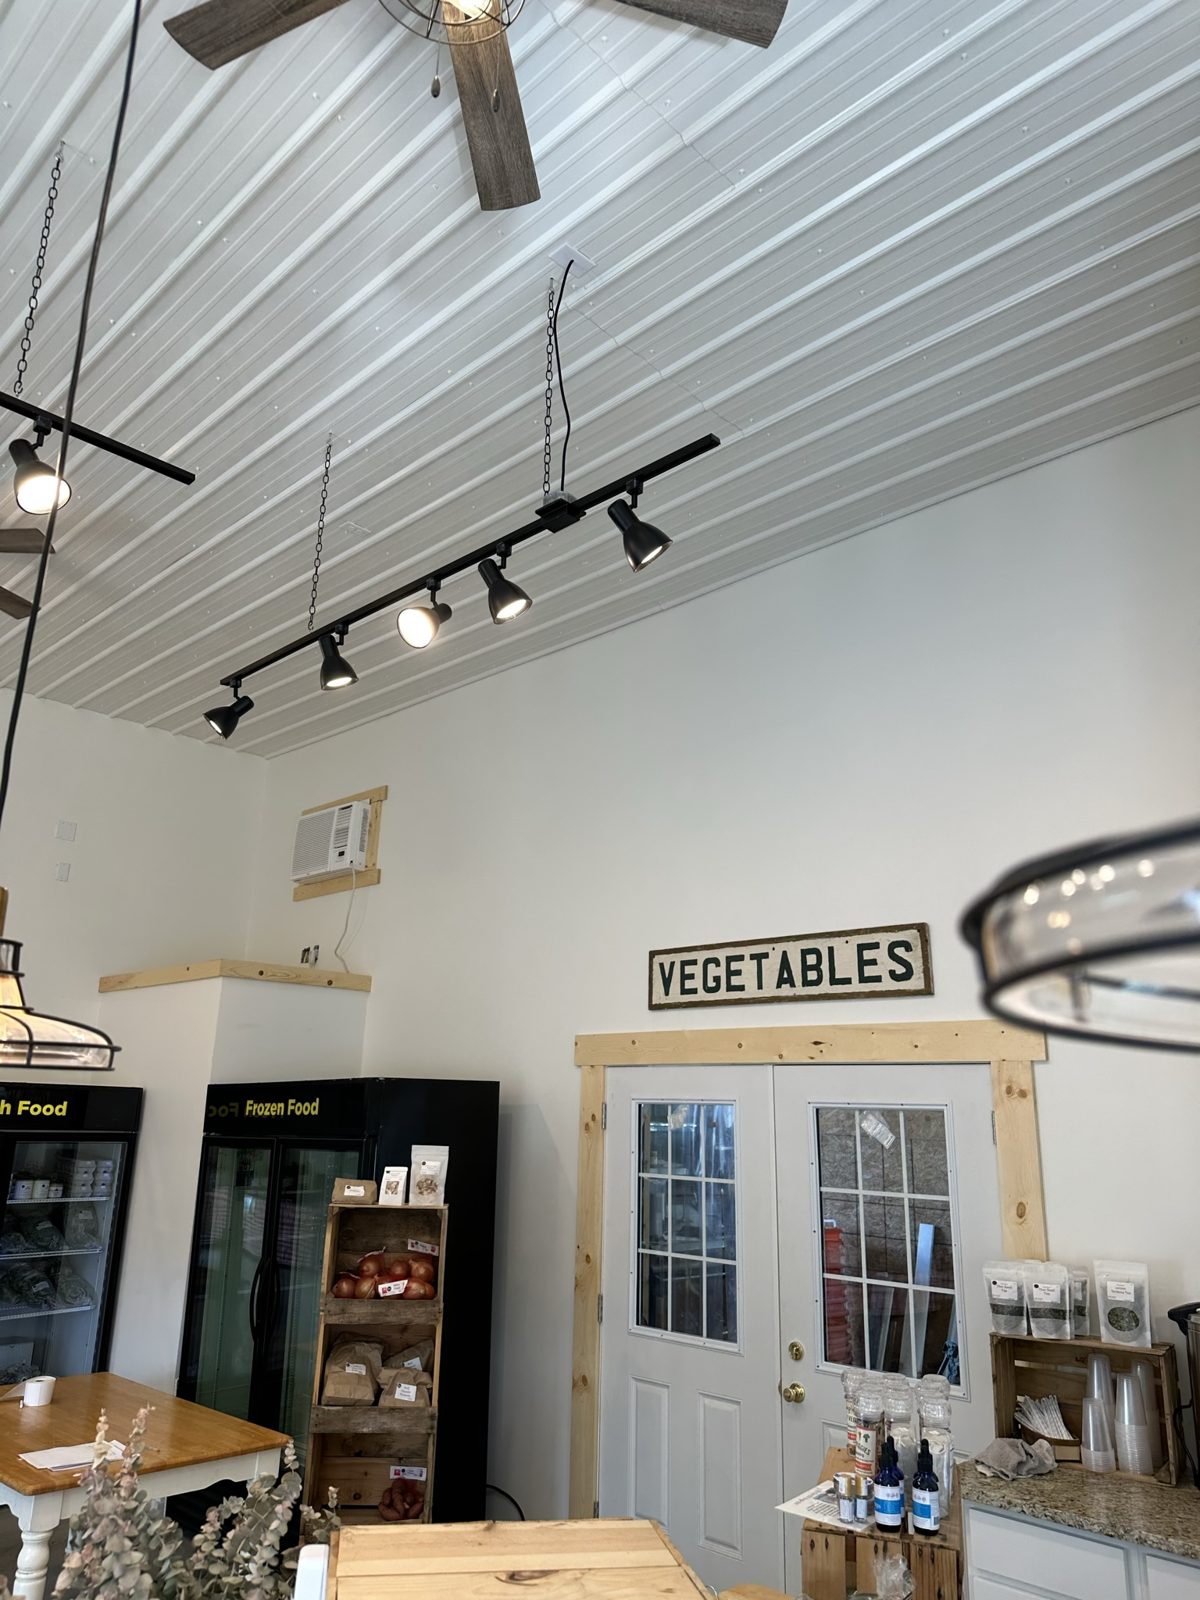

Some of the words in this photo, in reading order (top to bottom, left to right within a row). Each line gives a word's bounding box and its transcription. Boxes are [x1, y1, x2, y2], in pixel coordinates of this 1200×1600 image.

[659, 940, 914, 997] VEGETABLES
[17, 1100, 68, 1117] Food
[245, 1099, 285, 1116] Frozen
[287, 1097, 320, 1116] Food
